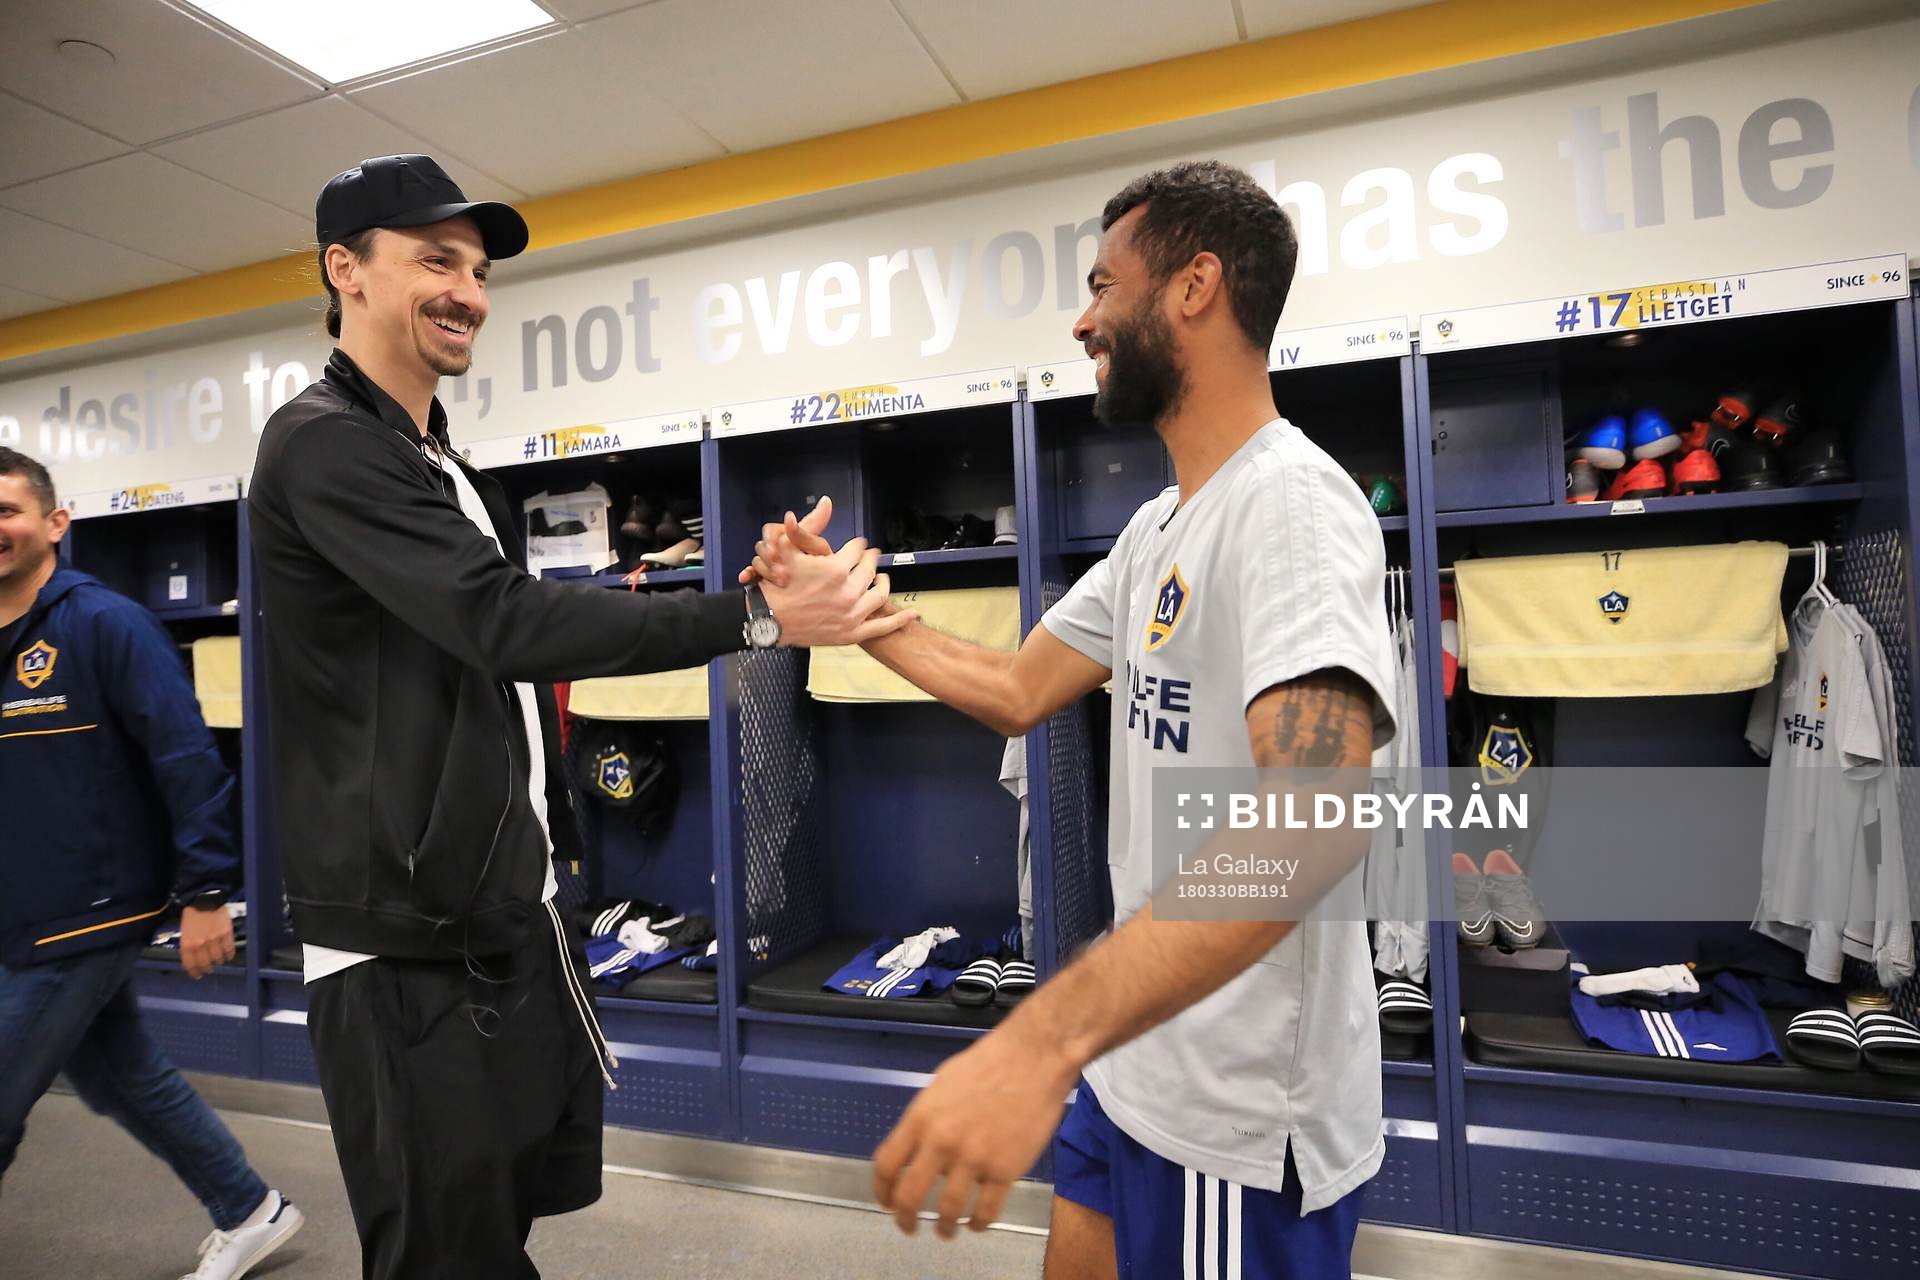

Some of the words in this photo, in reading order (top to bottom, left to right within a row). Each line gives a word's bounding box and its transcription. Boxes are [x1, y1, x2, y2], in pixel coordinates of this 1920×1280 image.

[39, 369, 223, 462] desire
[243, 351, 311, 433] to
[521, 277, 662, 392] not
[690, 217, 1100, 366] everyon
[1557, 91, 1835, 236] the
[1556, 292, 1632, 332] #17
[1638, 294, 1734, 324] LLETGET
[1827, 274, 1866, 290] SINCE
[1882, 269, 1901, 283] 96
[1636, 277, 1746, 302] SEBASTIAN
[1346, 334, 1376, 347] SINCE
[1388, 331, 1404, 342] 96
[790, 393, 842, 424] #22
[844, 393, 926, 418] KLIMENTA
[967, 382, 991, 394] SINCE
[1001, 379, 1013, 389] 96
[843, 386, 885, 403] EMRAH
[523, 433, 557, 459] #11
[563, 434, 622, 455] KAMARA
[661, 423, 681, 434] SINCE
[110, 489, 140, 512] #24
[1601, 551, 1622, 571] 17
[1157, 597, 1175, 623] LA
[1603, 600, 1625, 613] LA
